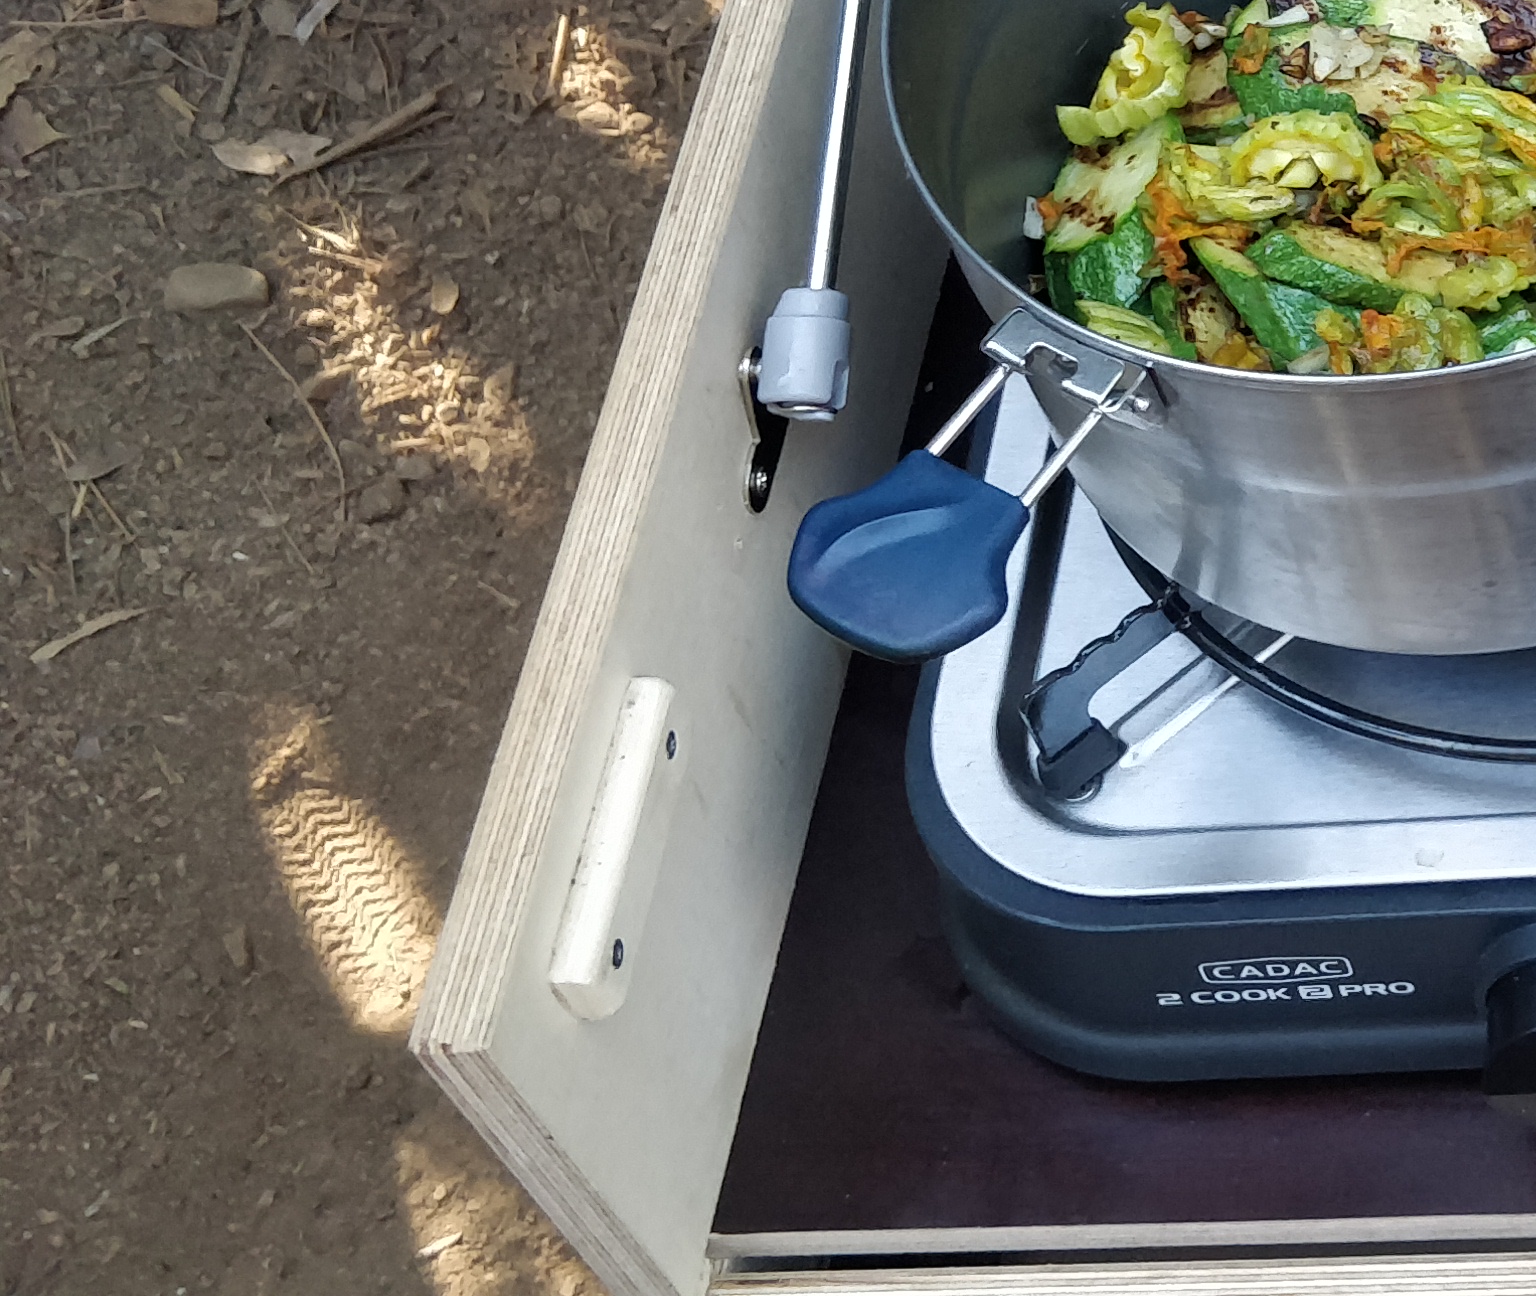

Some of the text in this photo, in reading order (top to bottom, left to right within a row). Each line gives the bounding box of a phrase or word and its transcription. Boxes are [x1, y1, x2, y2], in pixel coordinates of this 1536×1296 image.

[1212, 960, 1343, 979] CADAC
[1155, 992, 1184, 1006] 2
[1190, 988, 1292, 1004] COOK
[1338, 981, 1416, 997] PRO
